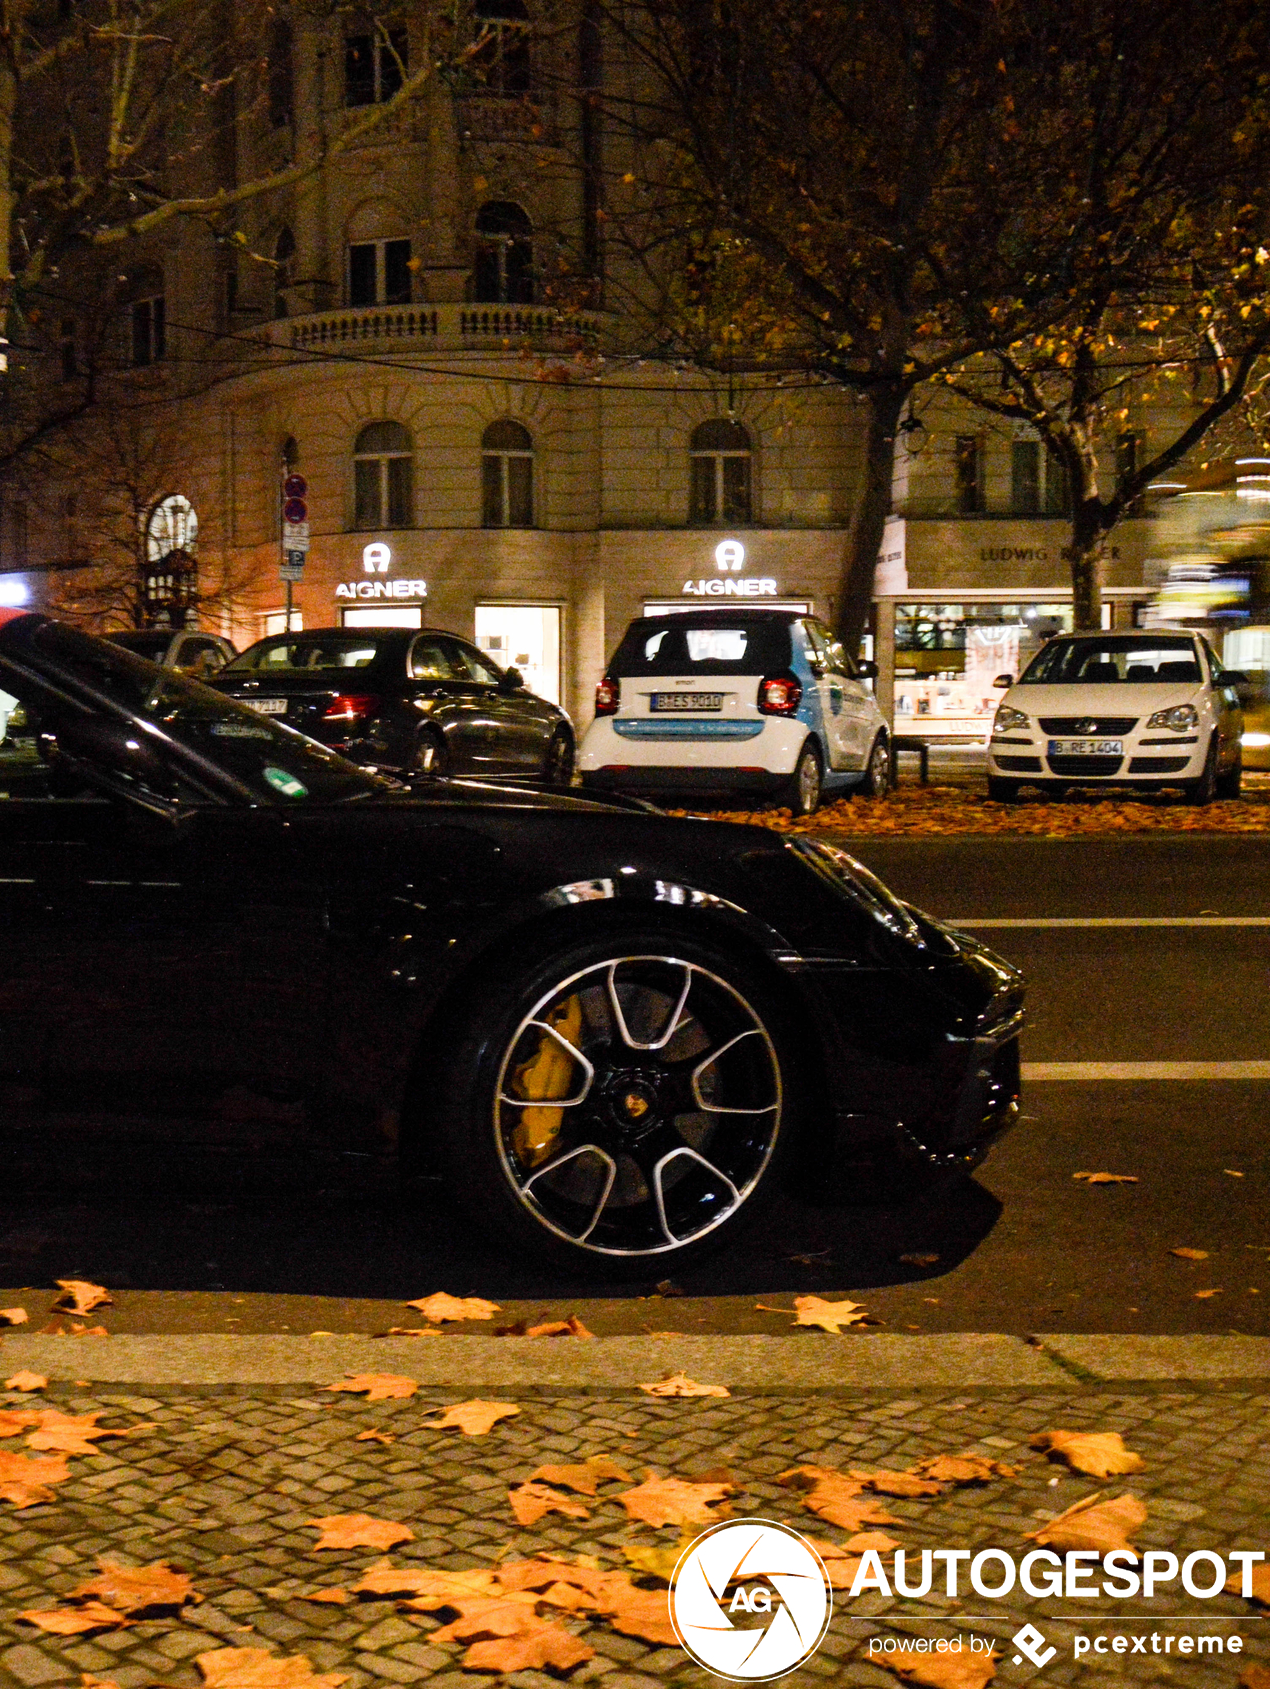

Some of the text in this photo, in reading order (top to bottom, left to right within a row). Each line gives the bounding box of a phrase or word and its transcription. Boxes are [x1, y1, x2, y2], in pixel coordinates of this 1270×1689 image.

[980, 548, 1047, 561] LUDWIG
[335, 579, 427, 598] AIGNER
[682, 578, 777, 595] AIGNER
